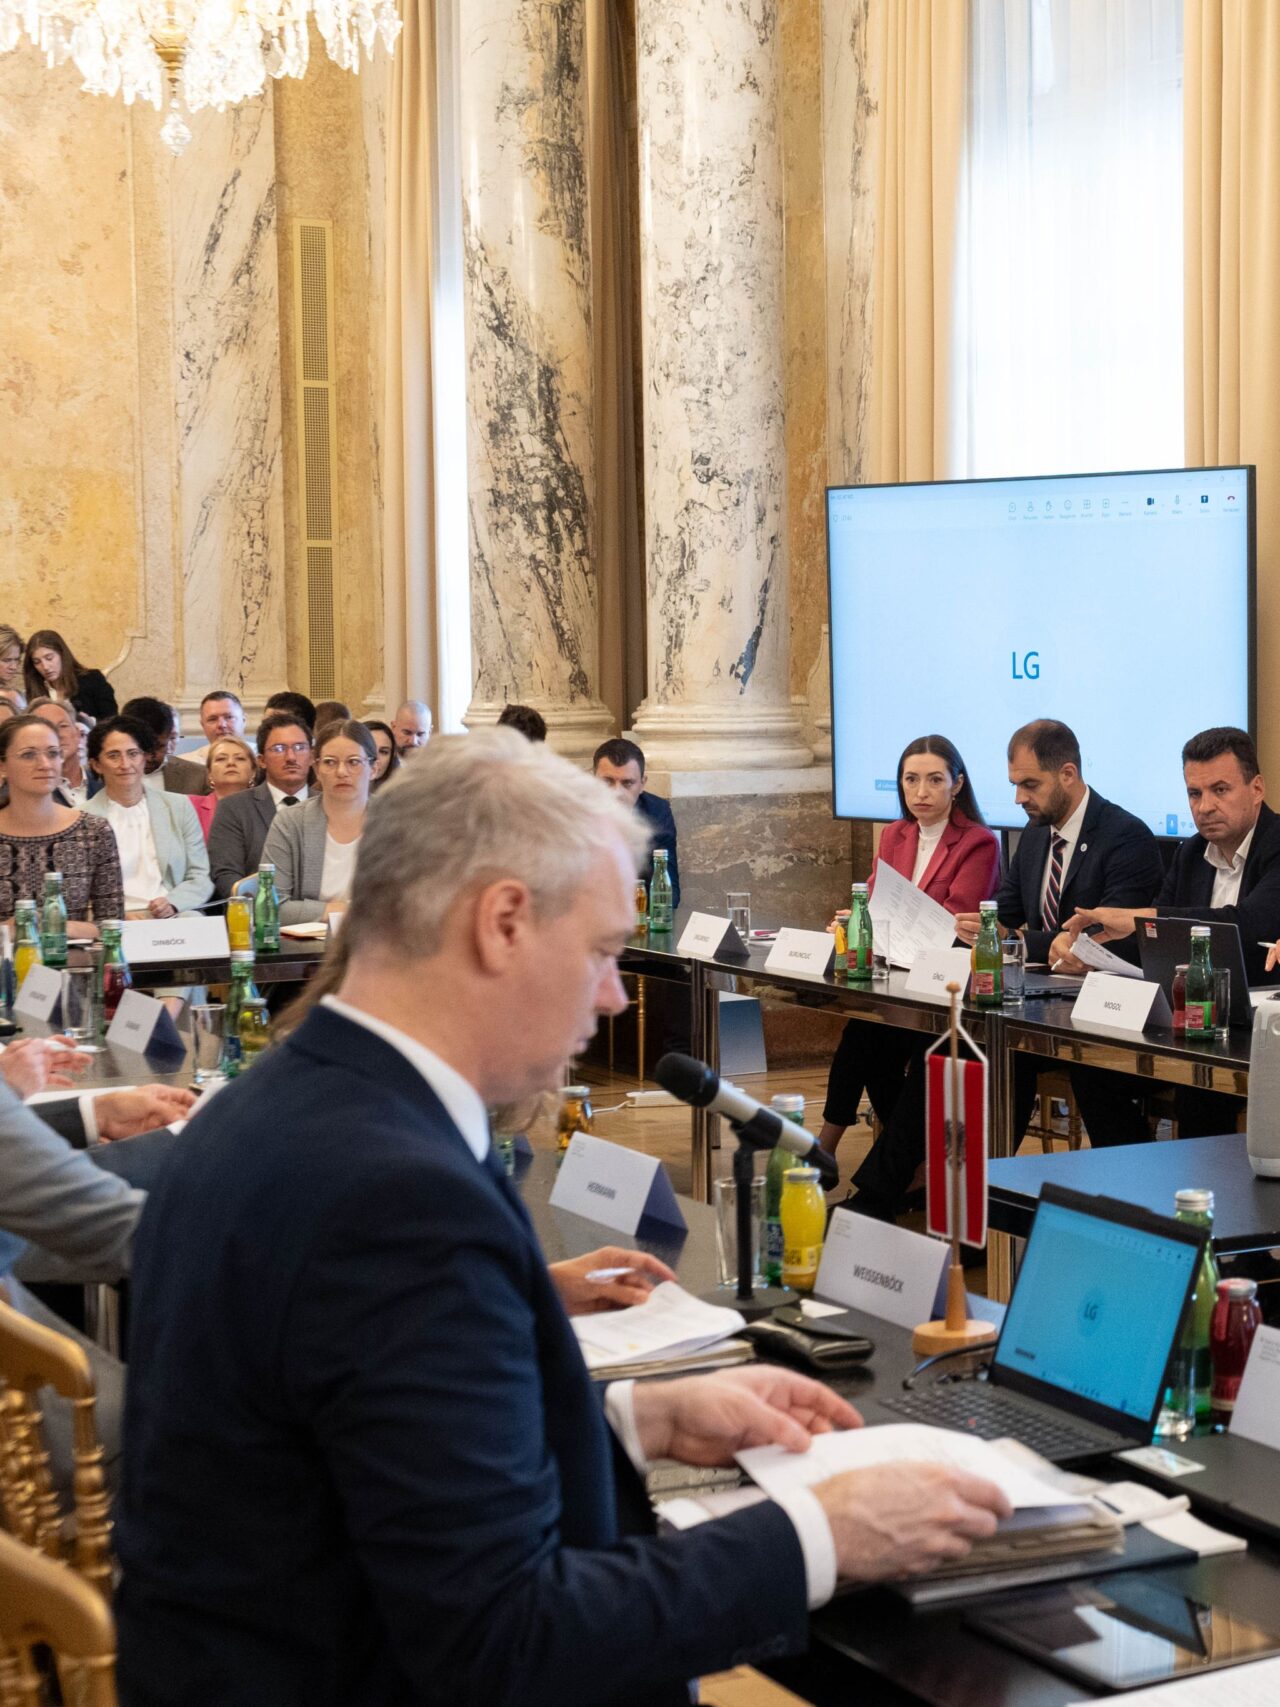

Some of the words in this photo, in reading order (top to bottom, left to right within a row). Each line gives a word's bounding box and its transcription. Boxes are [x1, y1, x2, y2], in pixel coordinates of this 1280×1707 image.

[1012, 651, 1040, 680] LG
[853, 1263, 905, 1294] WEISSENBÖCK
[1083, 1302, 1099, 1322] LG
